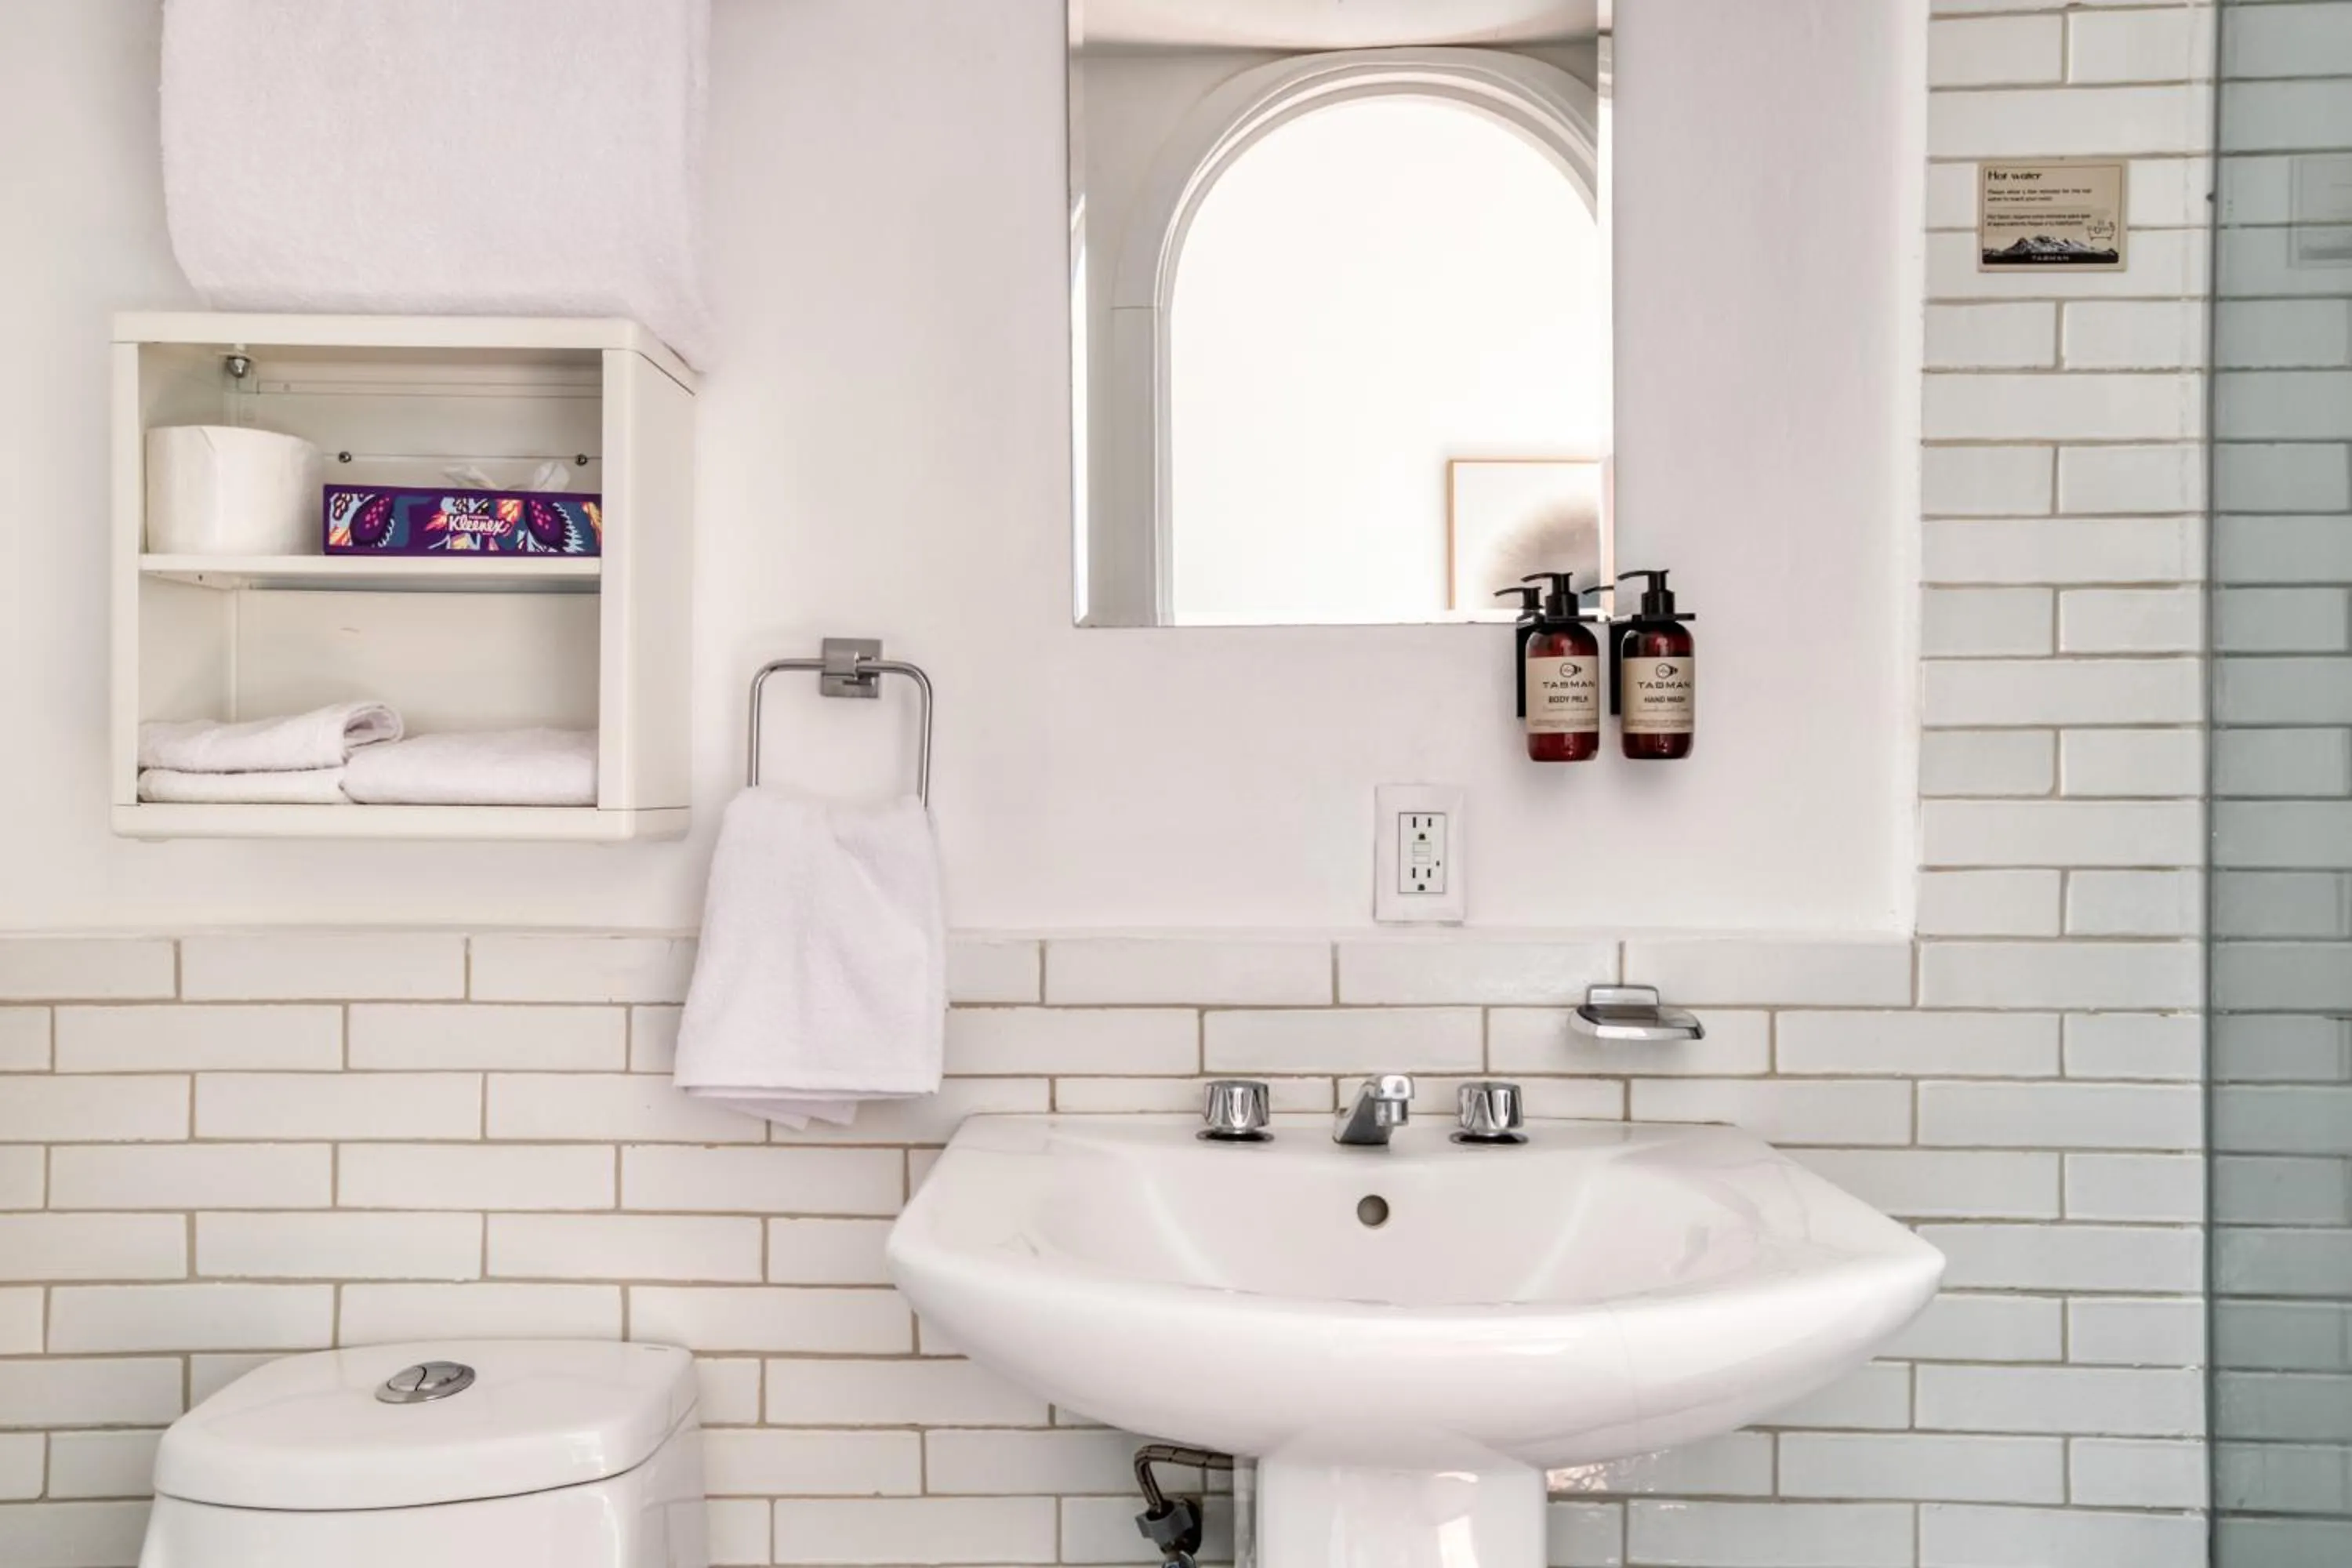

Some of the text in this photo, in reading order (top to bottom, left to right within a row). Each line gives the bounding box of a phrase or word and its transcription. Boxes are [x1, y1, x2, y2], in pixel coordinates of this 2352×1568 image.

[1987, 171, 2042, 180] Hot water
[449, 514, 510, 535] Kleenex
